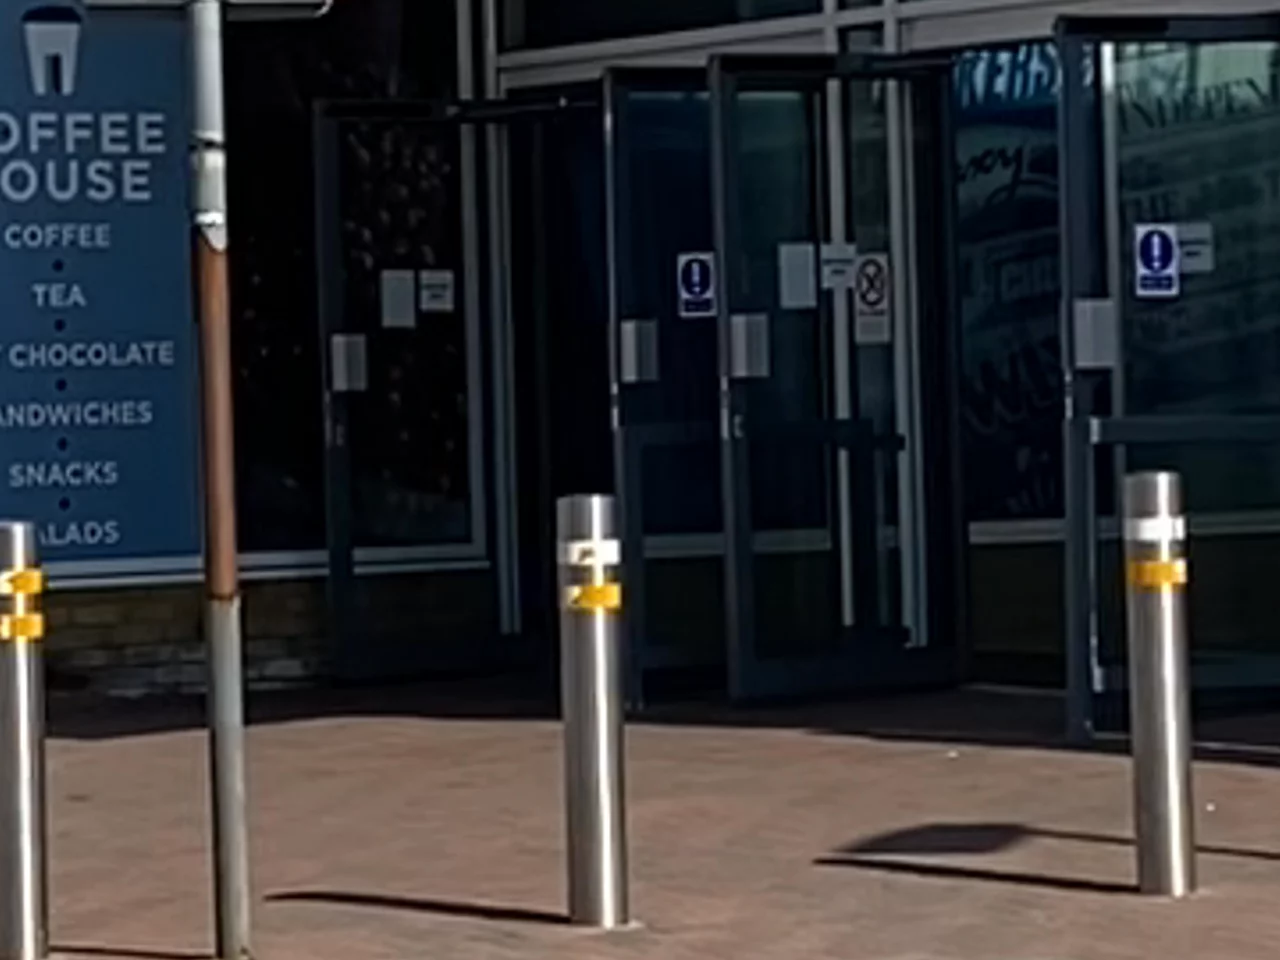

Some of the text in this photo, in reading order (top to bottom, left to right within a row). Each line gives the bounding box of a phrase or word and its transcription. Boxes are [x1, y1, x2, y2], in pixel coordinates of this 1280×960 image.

[4, 223, 111, 249] COFFEE
[31, 283, 87, 308] TEA
[7, 340, 175, 368] CHOCOLATE
[8, 461, 119, 488] SNACKS
[38, 520, 120, 545] LADS
